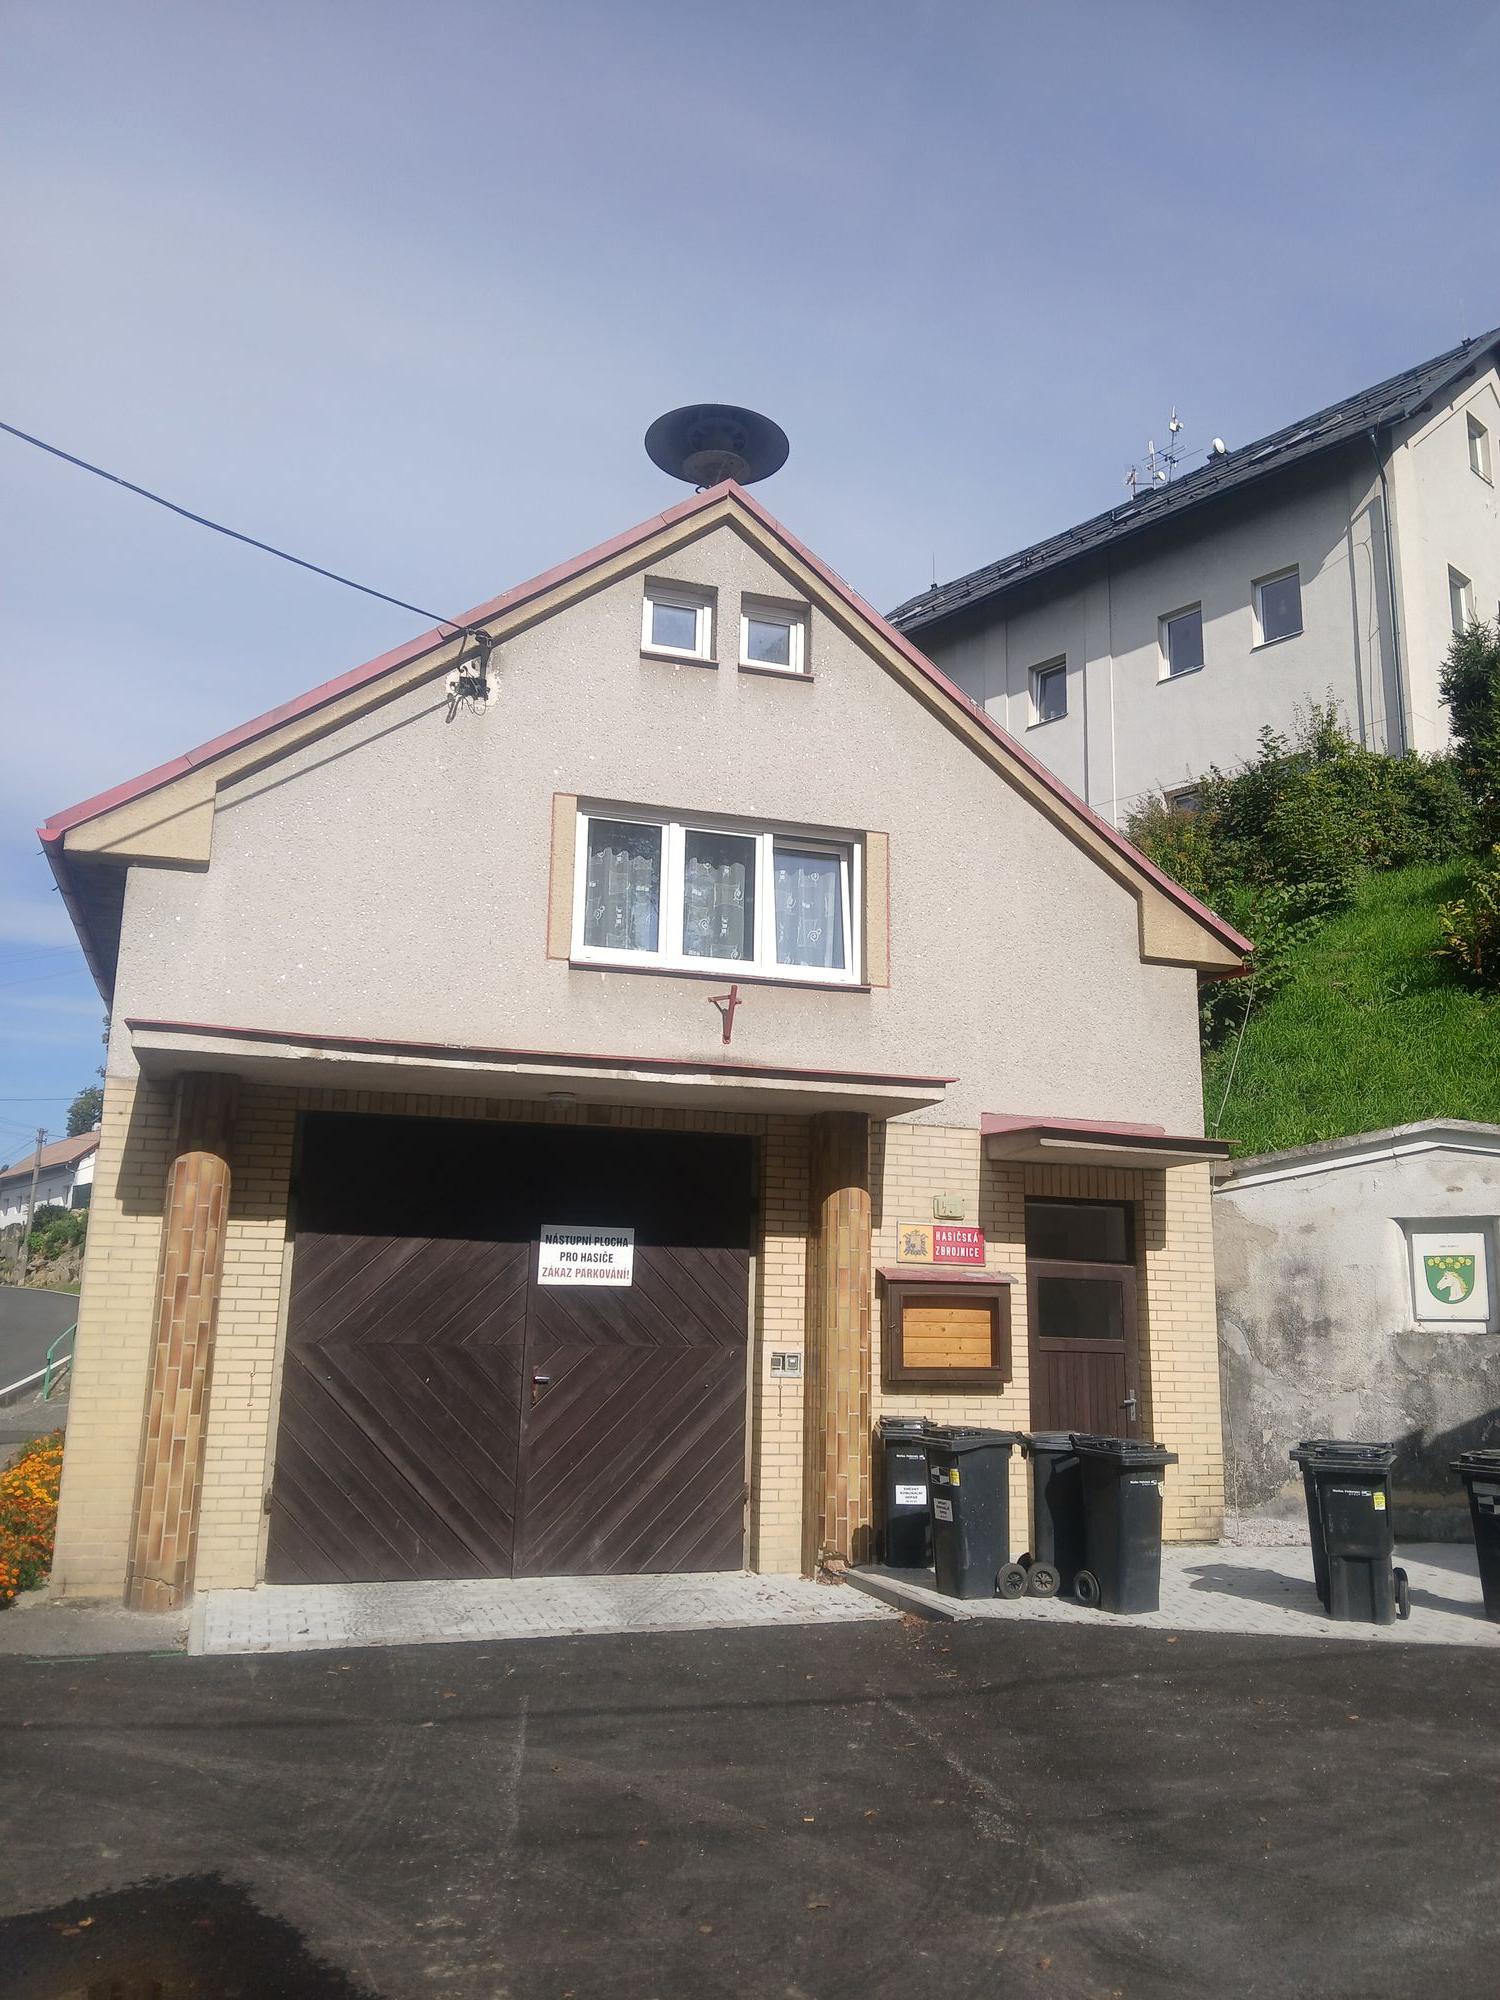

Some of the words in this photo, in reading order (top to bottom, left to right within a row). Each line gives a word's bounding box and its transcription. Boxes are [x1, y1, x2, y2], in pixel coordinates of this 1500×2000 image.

[545, 1233, 592, 1246] NÁSTUPNÍ
[594, 1236, 628, 1247] PLOCHA
[935, 1231, 979, 1243] HASIČSKÁ
[559, 1251, 578, 1262] PRO
[580, 1251, 614, 1263] HASIČE
[935, 1246, 980, 1258] ZBROJNICE
[542, 1265, 572, 1278] ZÁKAZ
[575, 1267, 630, 1280] PARKOVÁNÍ!
